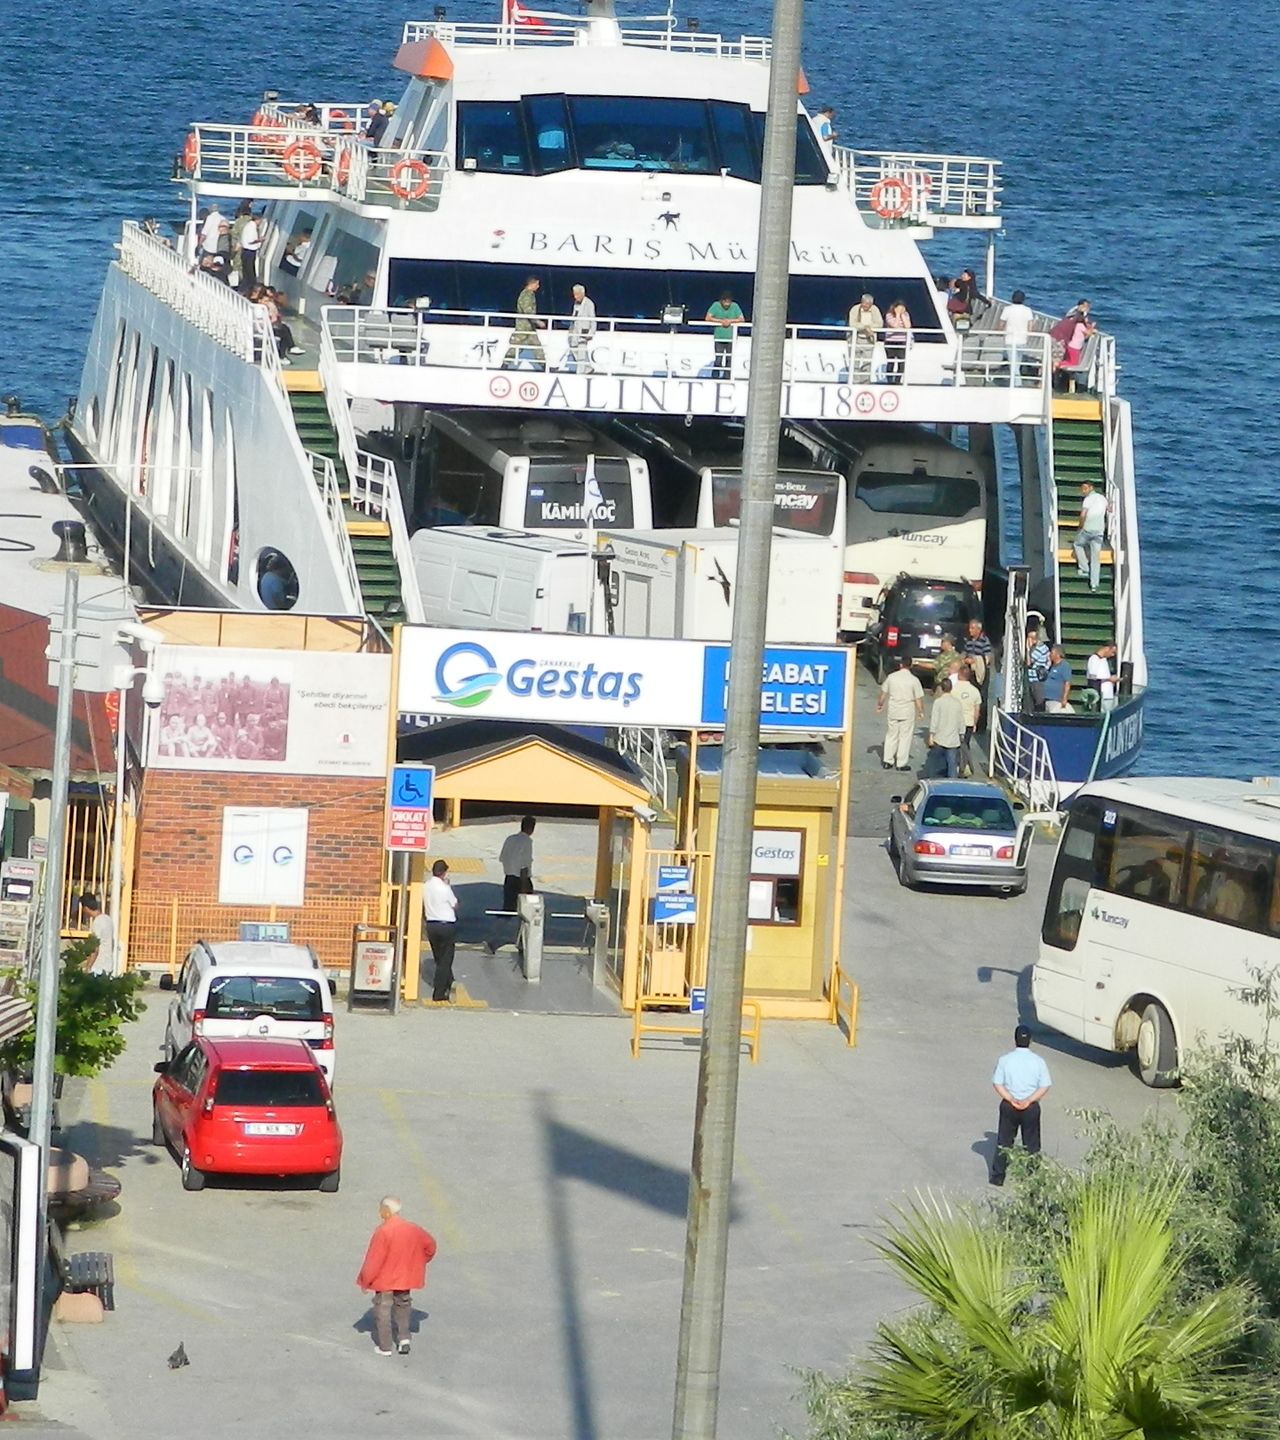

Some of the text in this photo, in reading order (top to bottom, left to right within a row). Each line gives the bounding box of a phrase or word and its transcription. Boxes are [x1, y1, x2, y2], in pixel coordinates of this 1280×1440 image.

[528, 232, 867, 267] BARIŞ Mükün
[820, 385, 852, 418] 18
[774, 493, 818, 510] ncay
[506, 657, 644, 707] Gestaş
[724, 660, 829, 686] EABAT
[723, 685, 827, 714] İELESİ
